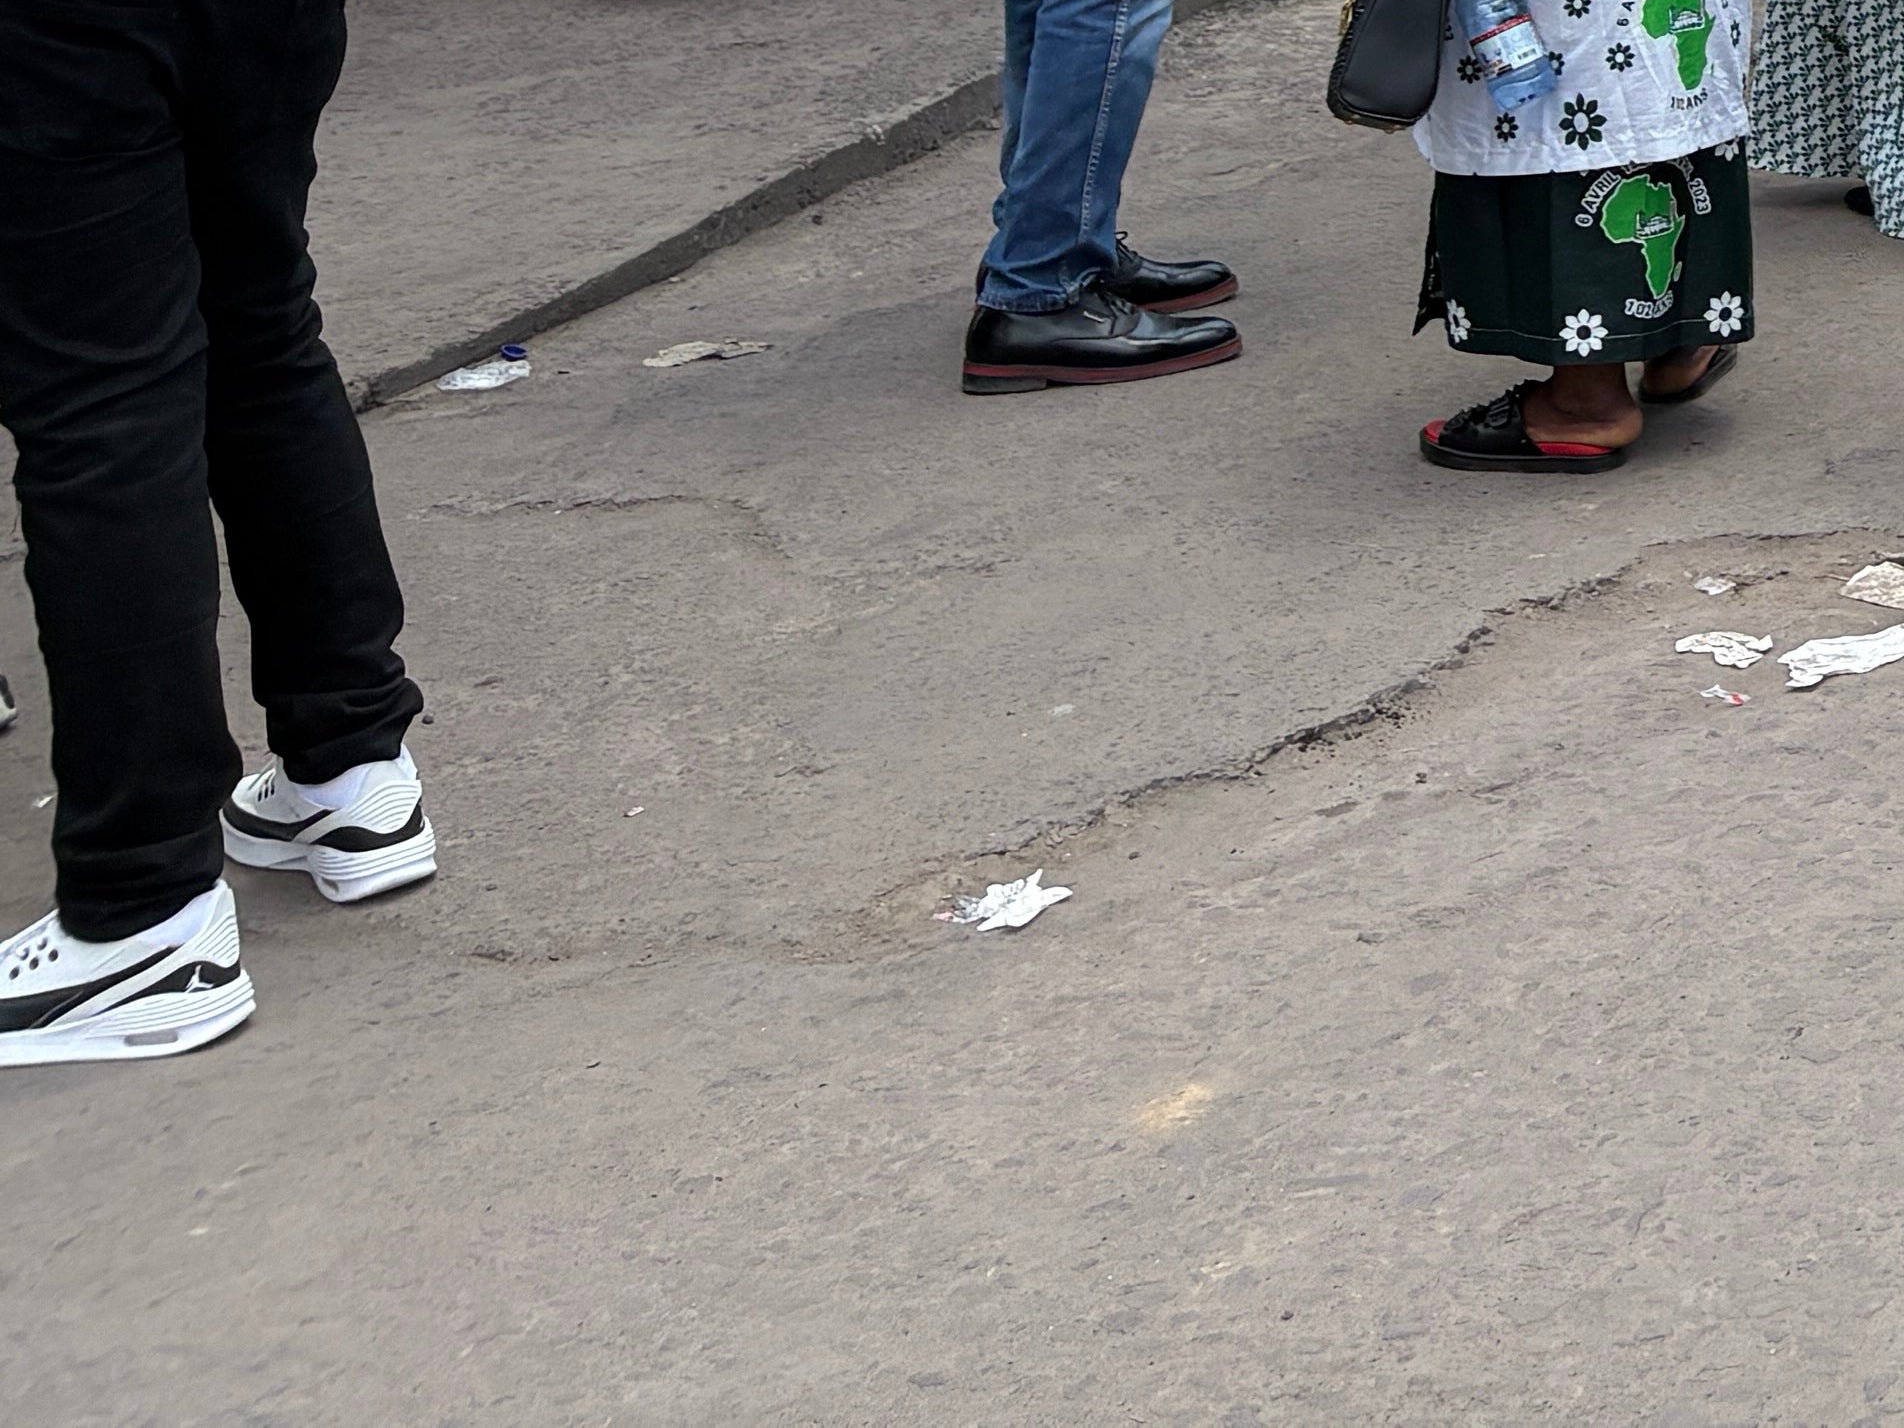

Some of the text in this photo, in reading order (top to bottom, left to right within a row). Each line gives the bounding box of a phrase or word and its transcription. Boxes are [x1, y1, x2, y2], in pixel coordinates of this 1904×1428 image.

[1616, 17, 1630, 27] 6
[1581, 171, 1622, 214] AVRIL
[1687, 178, 1712, 215] 2023
